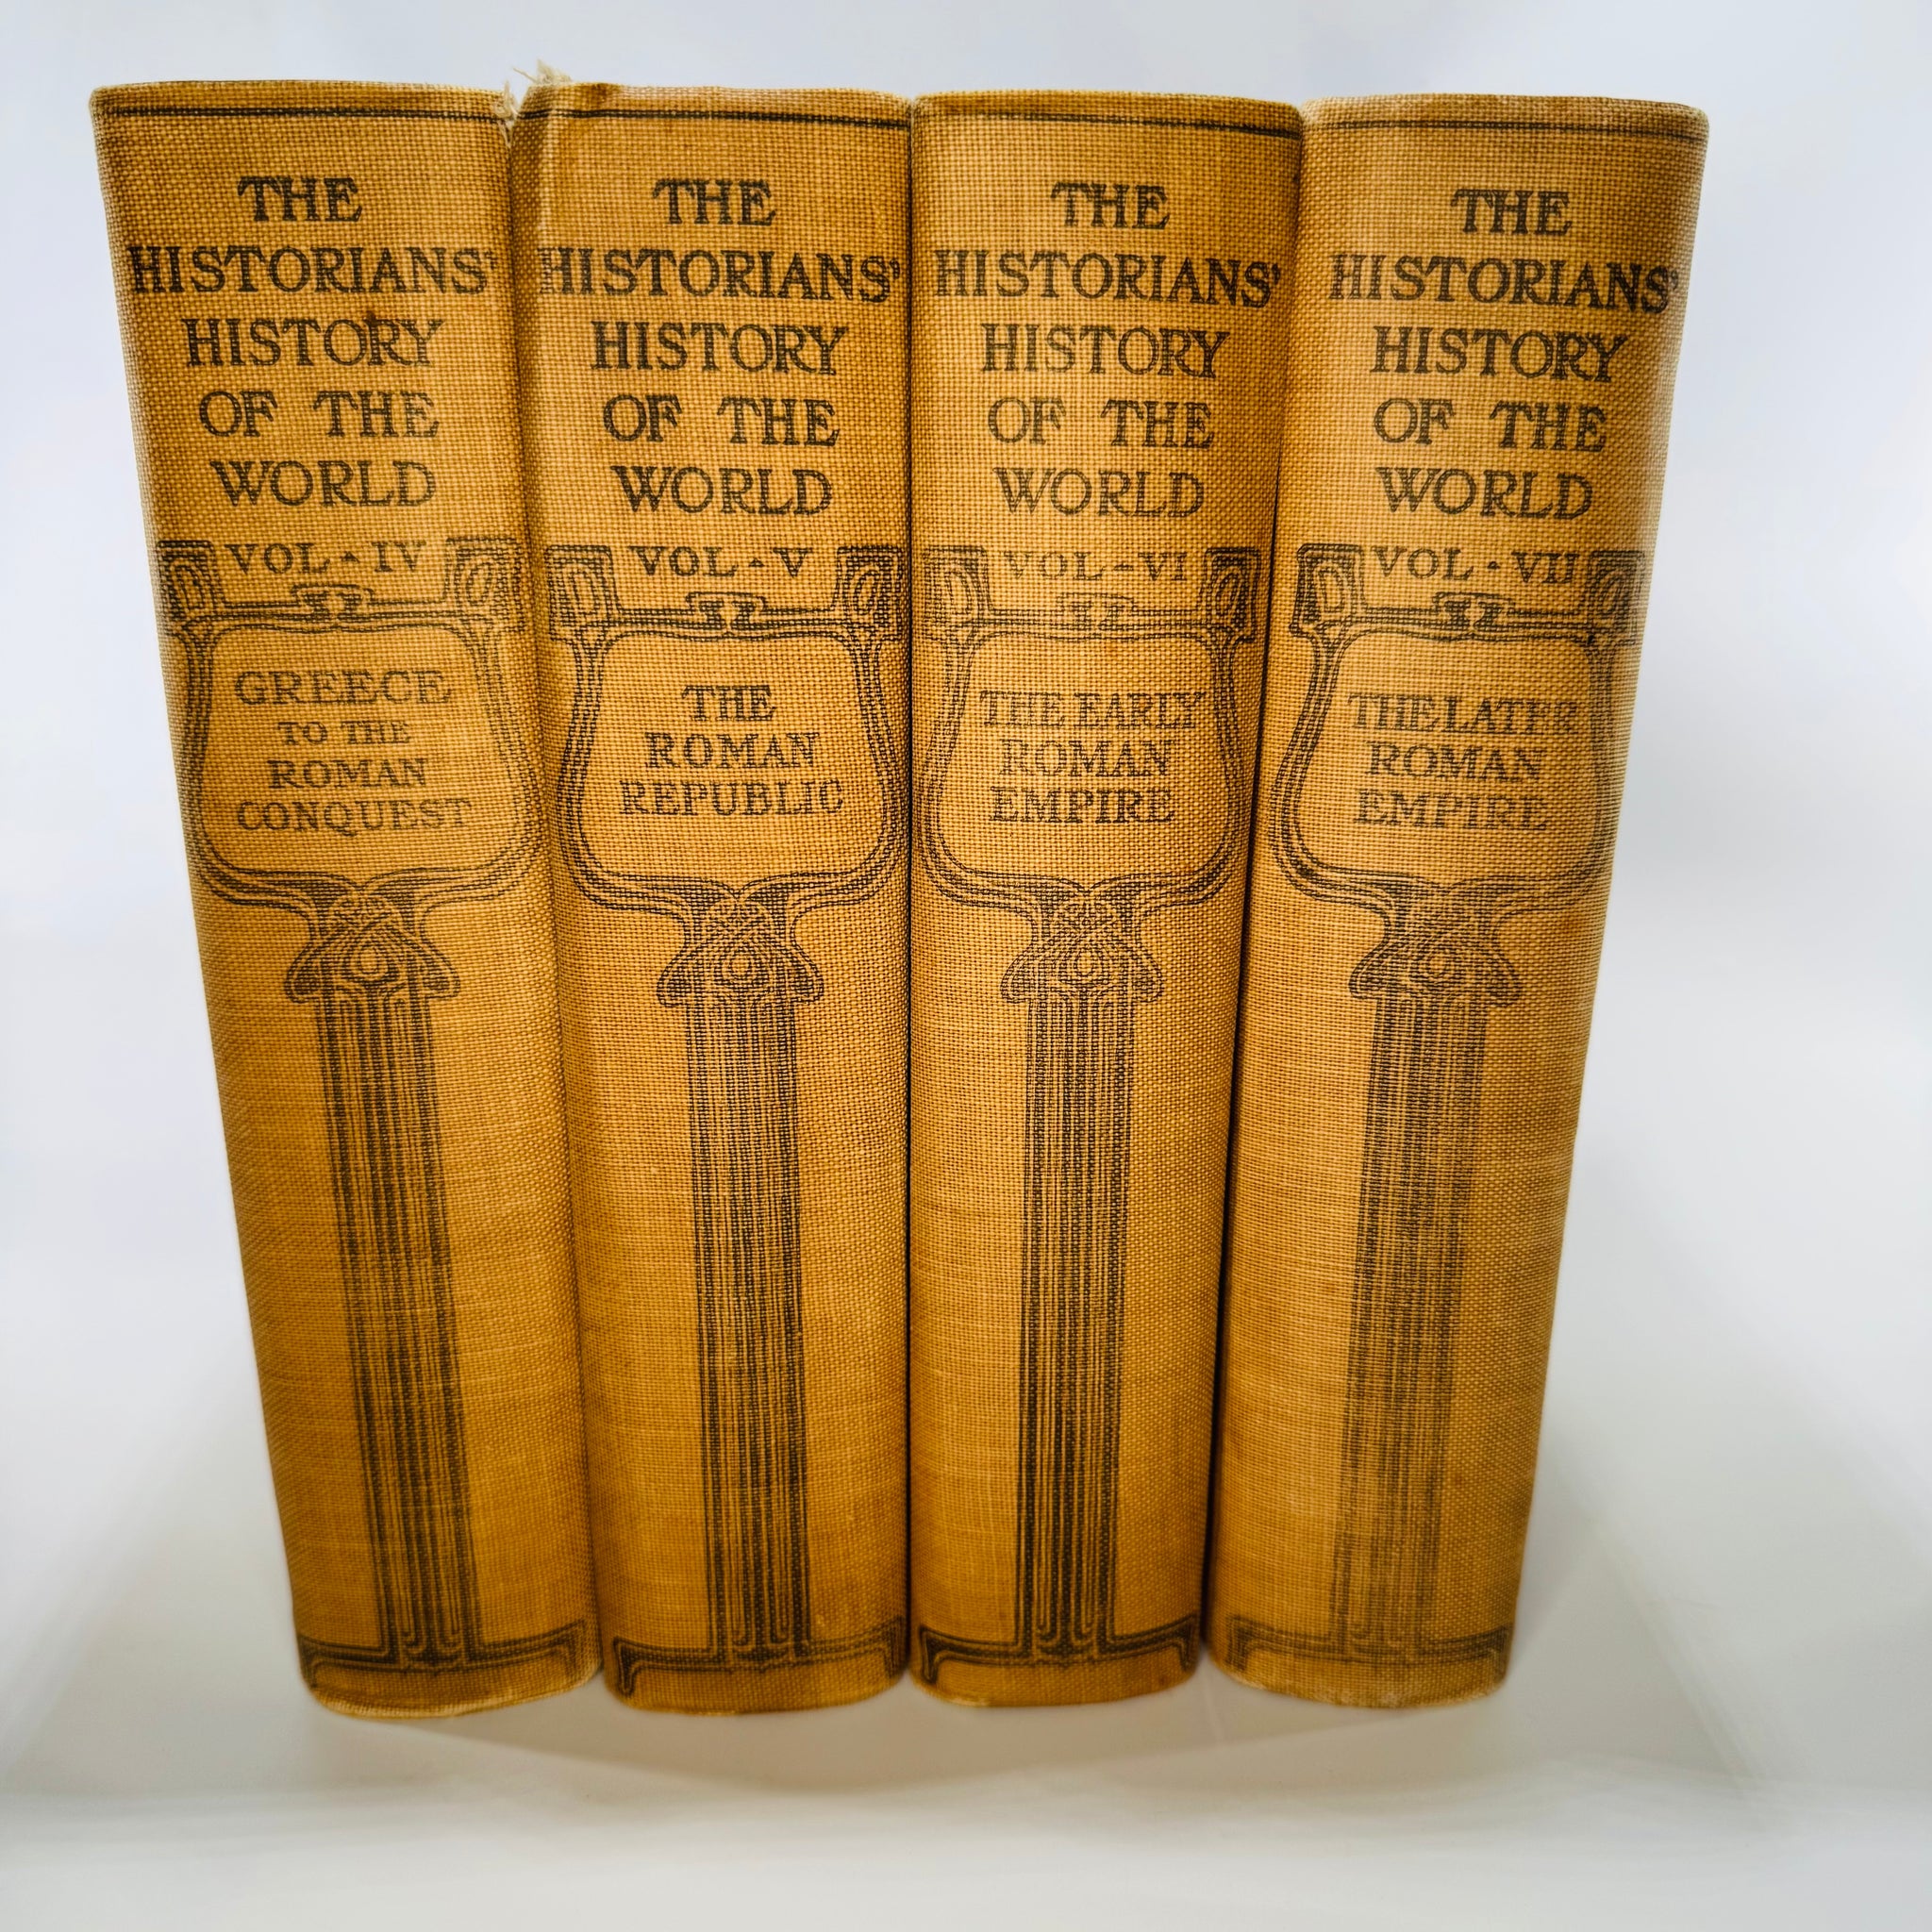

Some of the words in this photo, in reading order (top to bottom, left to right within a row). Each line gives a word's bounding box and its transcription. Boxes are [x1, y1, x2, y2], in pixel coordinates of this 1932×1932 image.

[239, 176, 362, 222] THE
[653, 178, 776, 226] THE
[1051, 181, 1170, 229] THE
[1451, 189, 1573, 236] THE
[182, 318, 444, 366] HISTORY
[591, 322, 849, 375] HISTORY
[981, 324, 1230, 377] HISTORY
[1371, 325, 1628, 383] HISTORY
[199, 391, 277, 437] OF
[313, 391, 440, 438] THE
[603, 394, 683, 441] OF
[717, 397, 840, 446] THE
[988, 397, 1066, 445] OF
[1101, 399, 1214, 448] THE
[1374, 398, 1455, 445] OF
[1490, 400, 1607, 453] THE
[210, 460, 436, 507] WORLD
[611, 465, 832, 515] WORLD
[992, 467, 1204, 517] WORLD
[1376, 467, 1593, 520] WORLD
[234, 670, 453, 706] GREECE
[681, 685, 776, 721] THE
[979, 691, 1067, 730] THE
[1074, 691, 1207, 730] EARLY
[278, 723, 328, 745] TO
[341, 721, 410, 744] THE
[1349, 693, 1436, 735] THE
[646, 731, 821, 769] ROMAN
[1000, 740, 1174, 776] ROMAN
[1365, 741, 1547, 782] ROMAN
[270, 759, 426, 789] ROMAN
[238, 801, 472, 836] CONQUEST
[619, 780, 843, 817] REPUBLIC
[990, 787, 1175, 824] EMPIRE
[1353, 791, 1548, 831] EMPIRE
